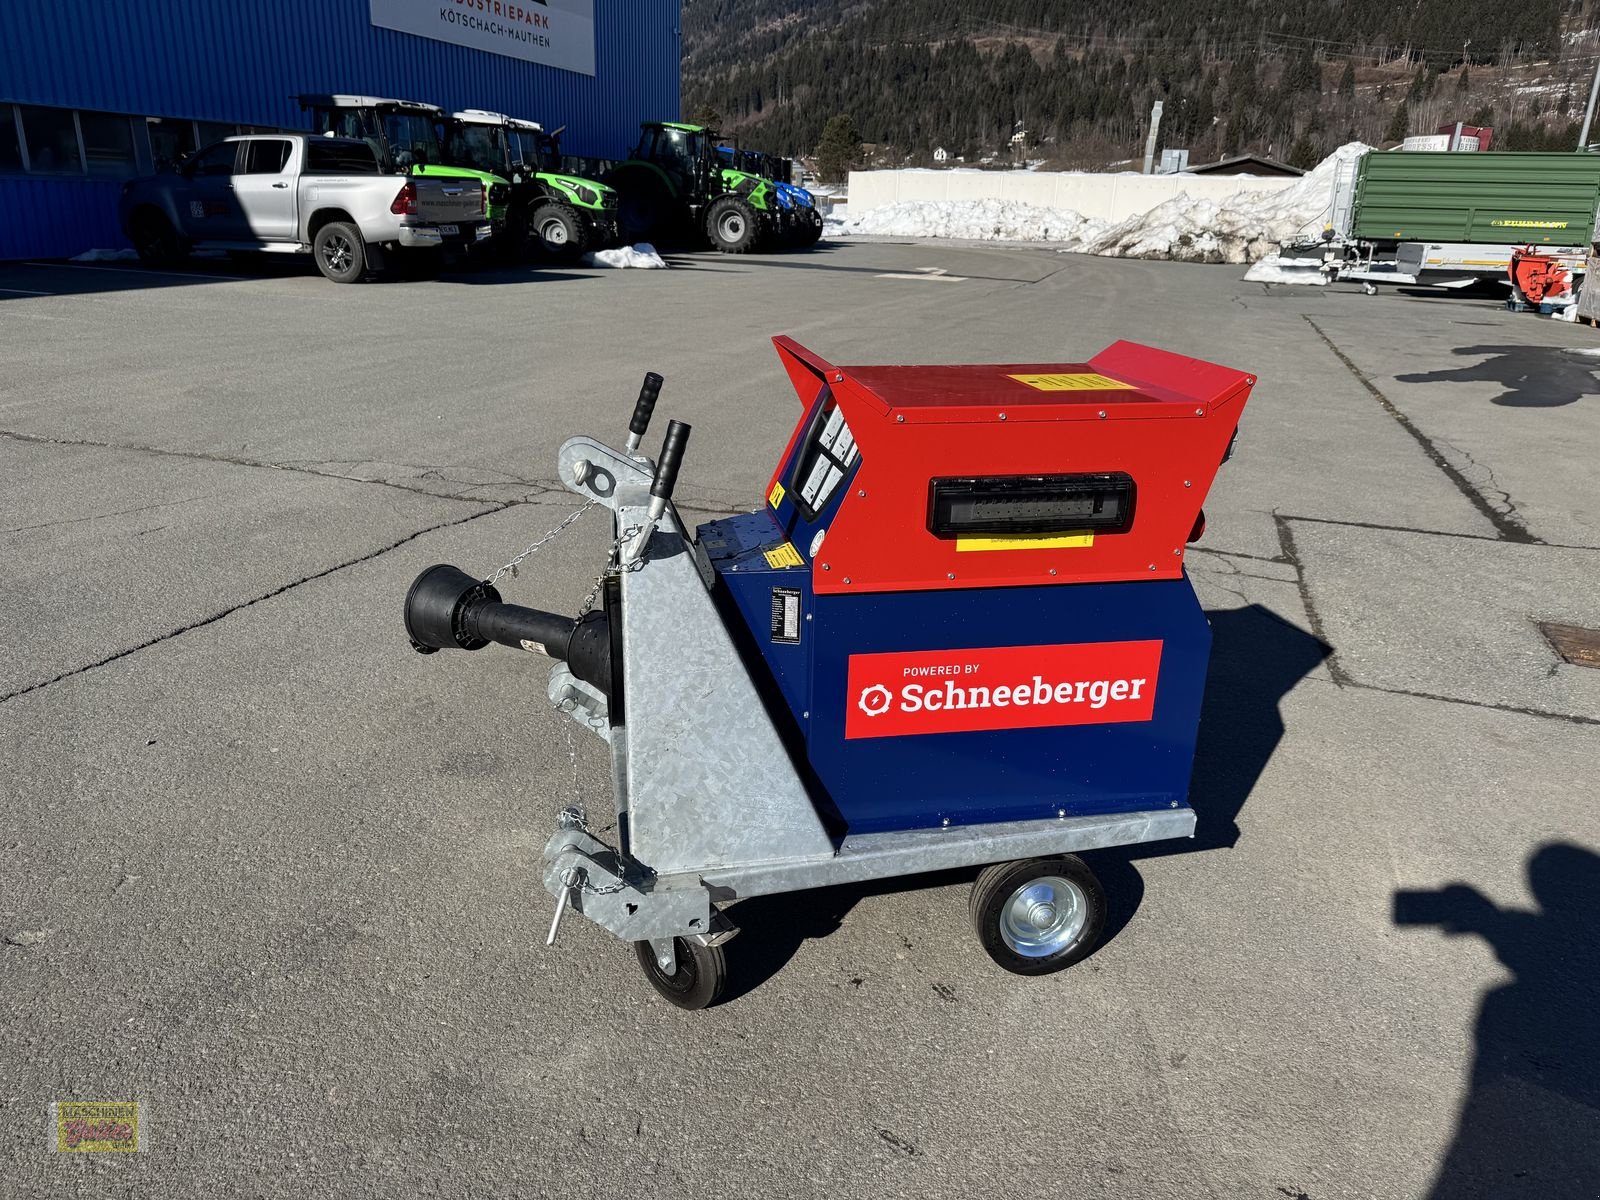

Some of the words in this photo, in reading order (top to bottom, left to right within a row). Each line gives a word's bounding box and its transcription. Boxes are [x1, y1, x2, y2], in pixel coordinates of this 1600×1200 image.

[440, 8, 550, 48] KÖTSCHACH-MAUTHEN
[903, 665, 960, 677] POWERED
[965, 664, 980, 674] BY
[900, 676, 1146, 712] Schneeberger
